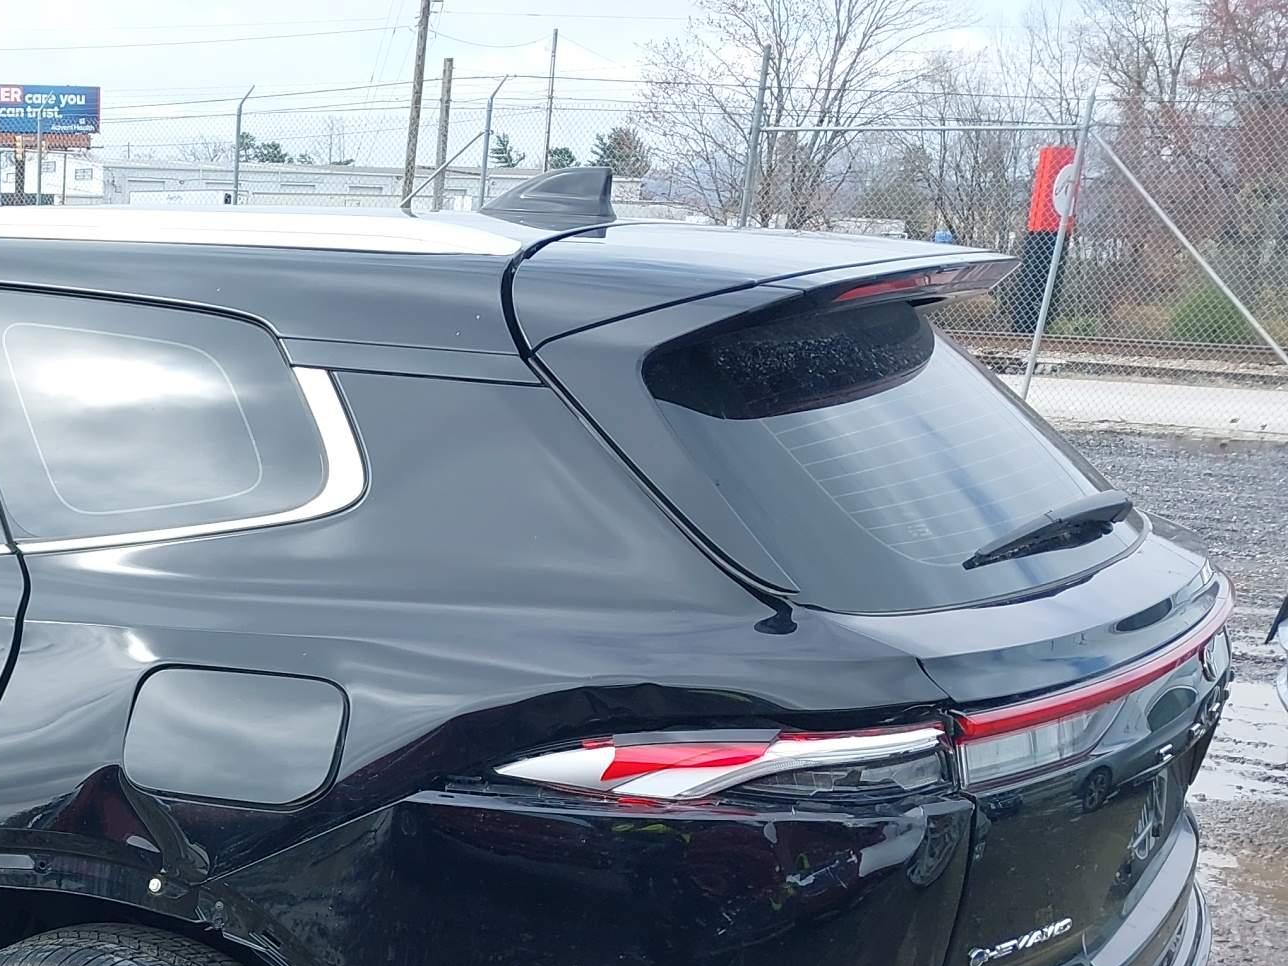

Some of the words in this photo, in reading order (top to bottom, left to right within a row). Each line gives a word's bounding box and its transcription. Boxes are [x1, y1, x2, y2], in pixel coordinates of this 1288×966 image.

[0, 88, 22, 102] ER
[25, 93, 56, 104] care
[60, 94, 86, 107] you
[0, 107, 25, 118] can
